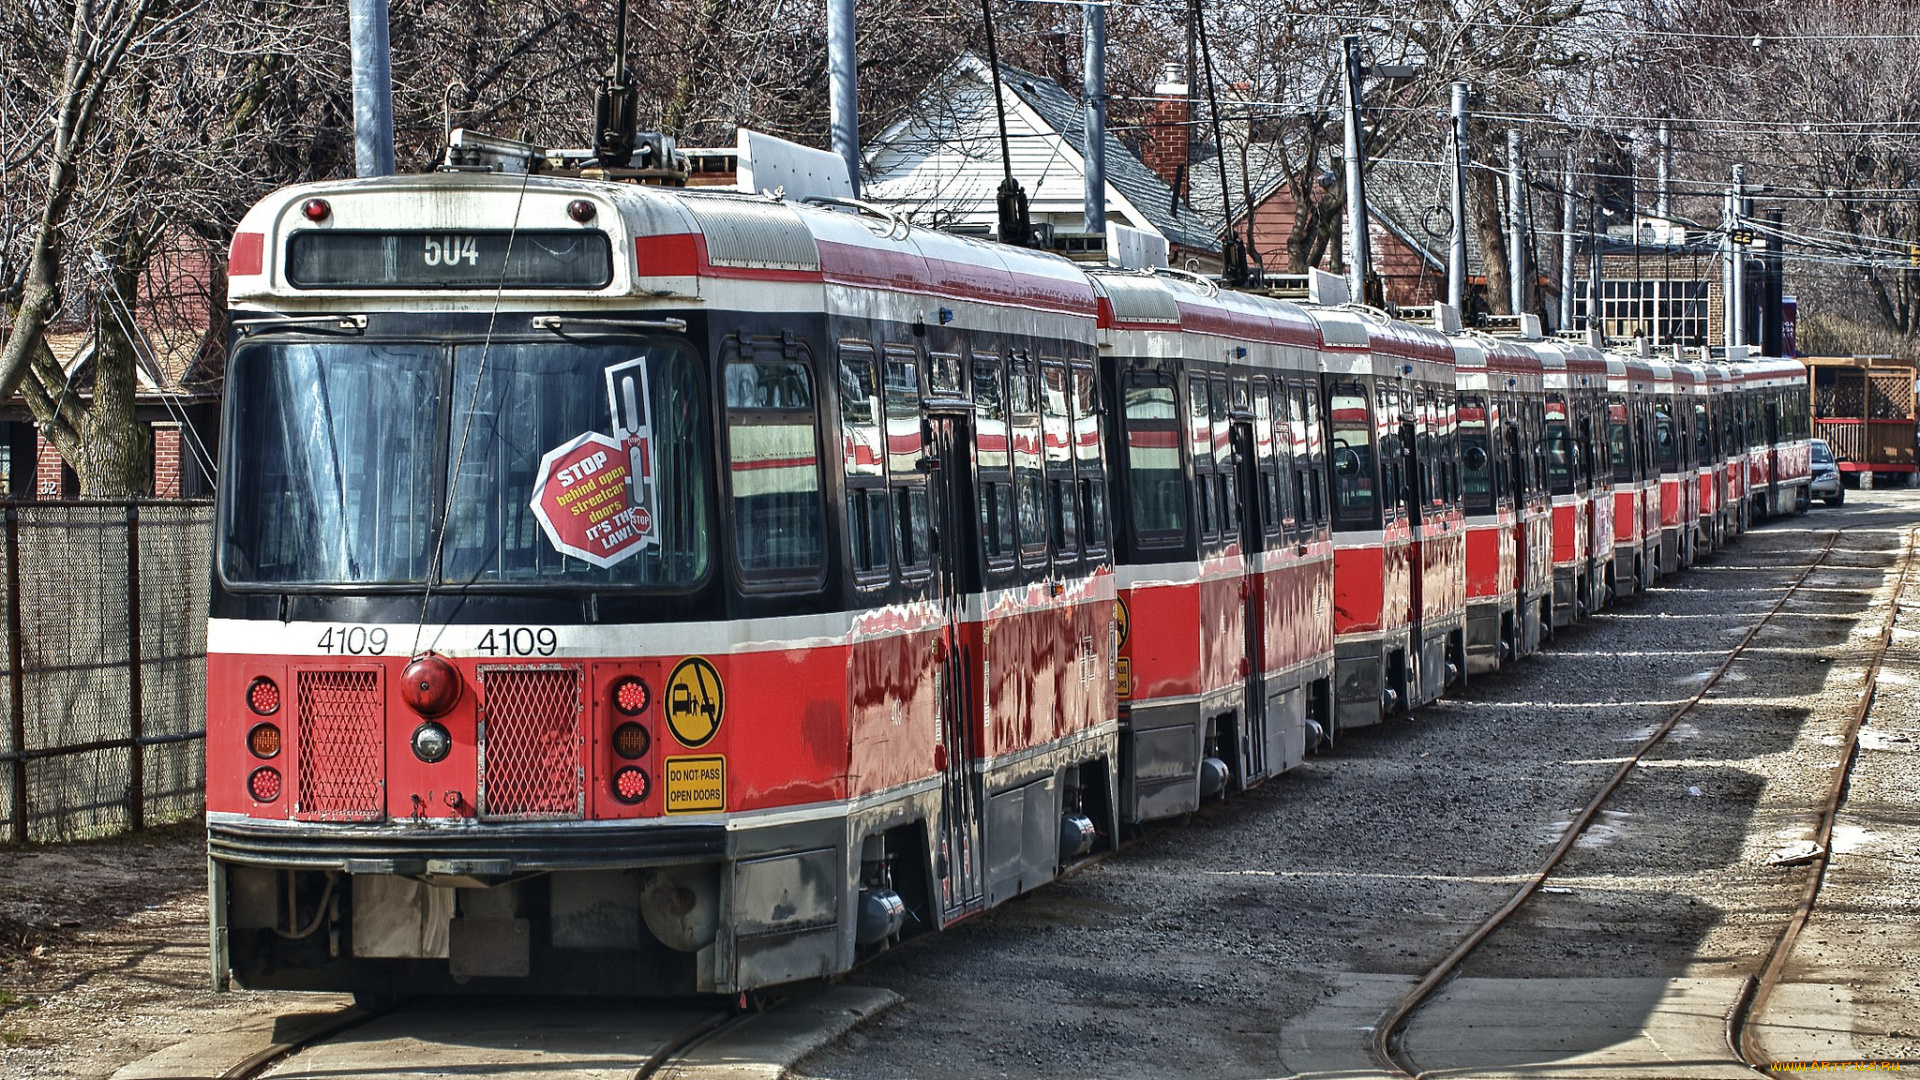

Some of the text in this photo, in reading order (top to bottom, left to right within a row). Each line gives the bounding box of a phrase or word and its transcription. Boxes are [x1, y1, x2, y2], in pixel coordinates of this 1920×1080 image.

[425, 235, 479, 266] 504
[556, 450, 608, 488] STOP
[40, 482, 57, 495] 32
[555, 465, 626, 507] behind open
[570, 482, 625, 516] streetcar
[585, 507, 634, 541] IT'S THE
[588, 500, 623, 523] doors
[632, 515, 649, 526] STOP
[601, 526, 633, 550] LAW!
[317, 626, 389, 655] 4109
[477, 627, 557, 656] 4109
[670, 768, 720, 781] DO NOT PASS
[670, 788, 720, 802] OPEN DOORS
